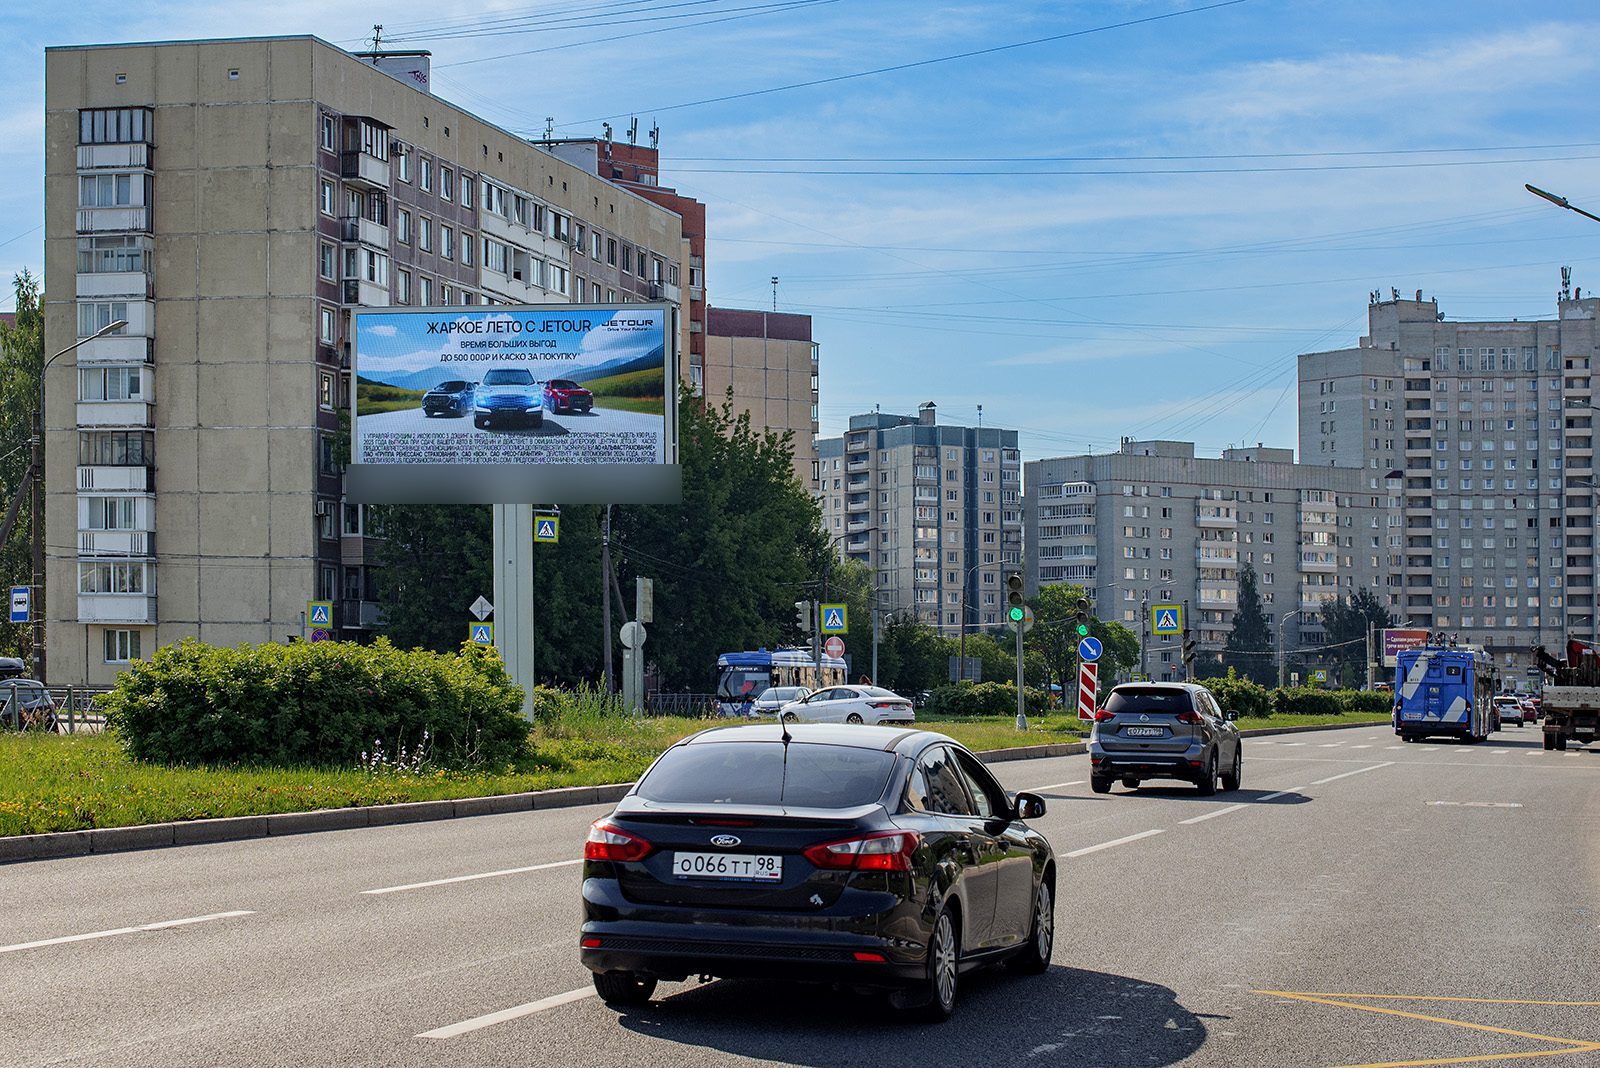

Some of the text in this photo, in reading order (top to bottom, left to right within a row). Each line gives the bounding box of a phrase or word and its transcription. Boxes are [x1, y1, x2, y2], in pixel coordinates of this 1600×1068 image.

[427, 320, 592, 334] ЖАРКОЕ ЛЕТО С JETOUR
[488, 340, 528, 348] БОЛЬШИХ
[529, 340, 557, 348] ВЫГОД
[441, 354, 453, 362] ДО
